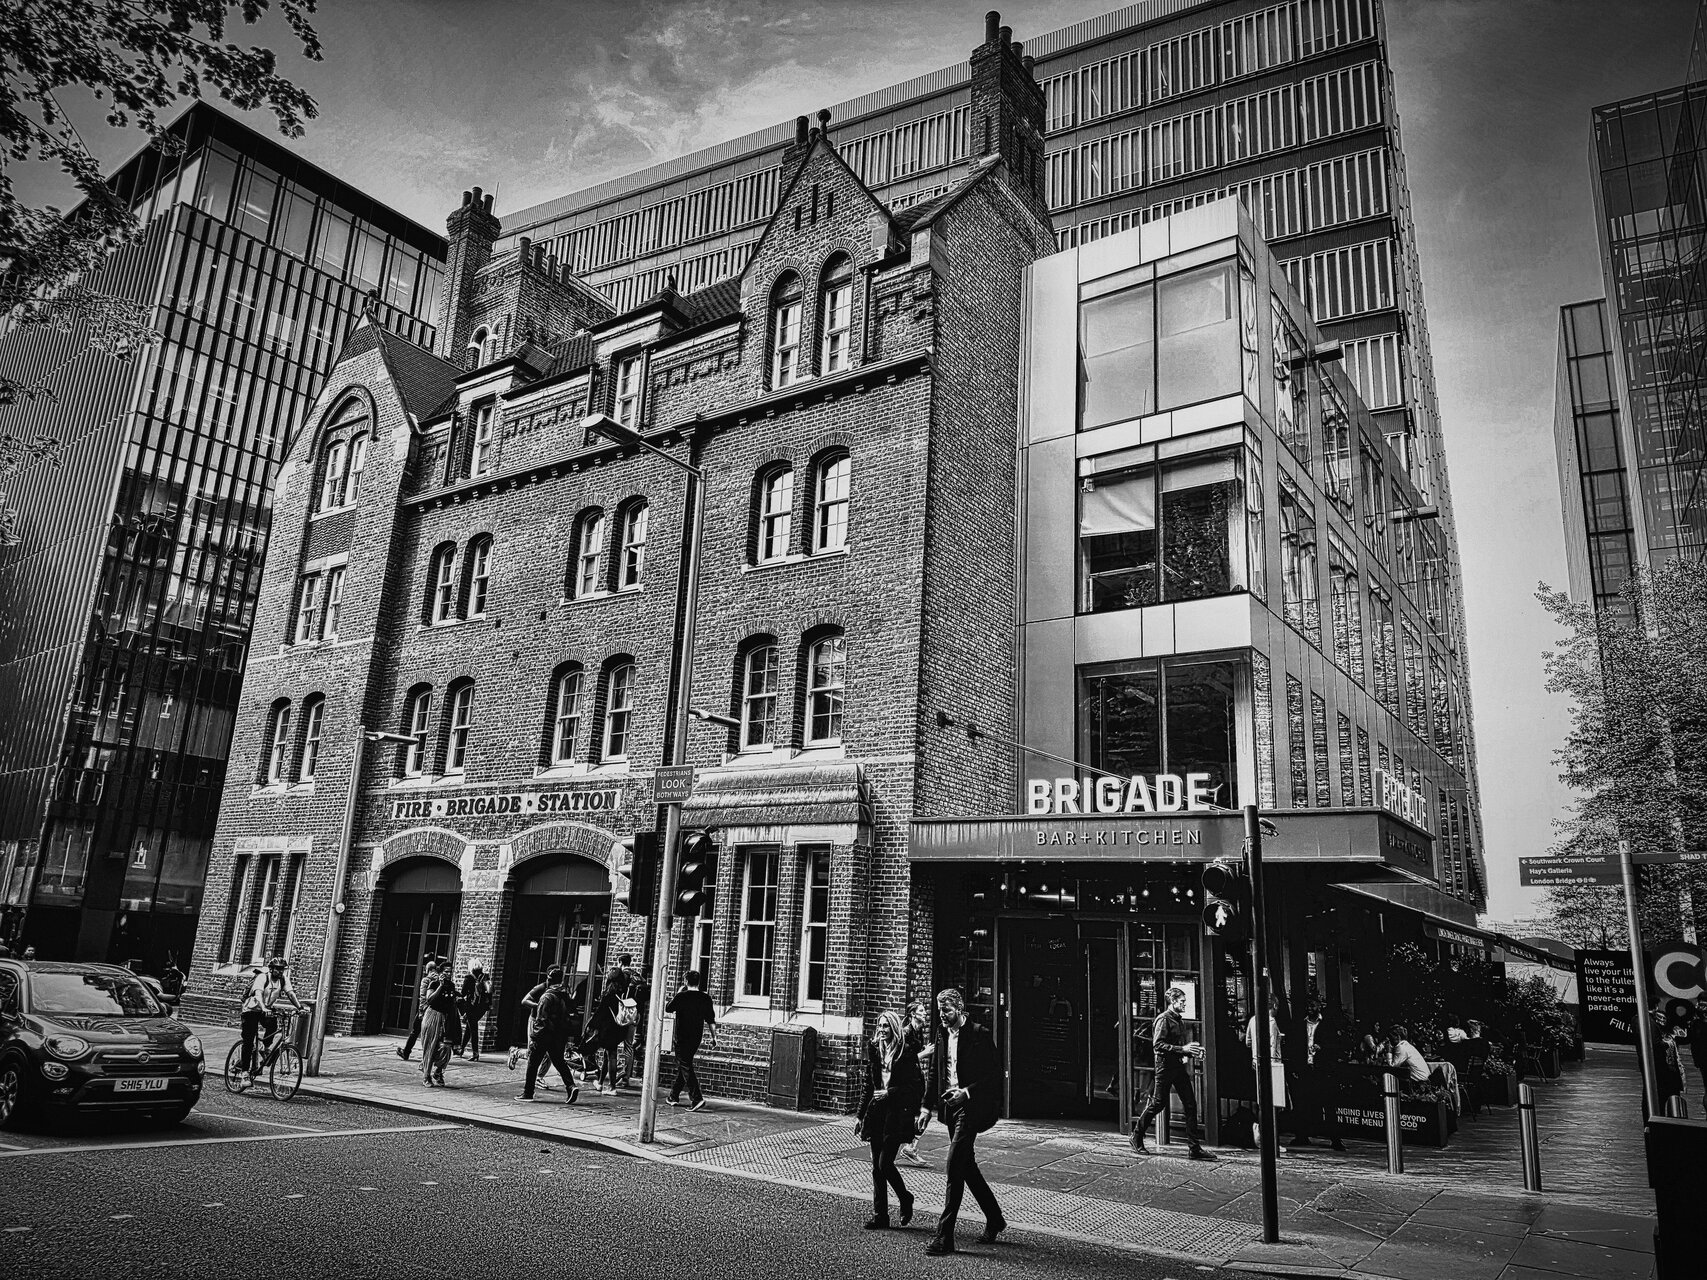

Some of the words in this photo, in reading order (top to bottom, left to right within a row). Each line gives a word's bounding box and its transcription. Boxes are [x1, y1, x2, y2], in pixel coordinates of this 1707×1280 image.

[661, 779, 686, 789] LOOK
[1028, 773, 1212, 815] BRIGADE
[395, 801, 433, 819] FIRE
[446, 796, 522, 816] BRIGADE
[537, 791, 617, 812] STATION
[1679, 853, 1701, 861] SHAD
[1583, 958, 1614, 968] Always
[1584, 967, 1599, 975] live
[1612, 977, 1635, 985] fulles
[1586, 985, 1602, 993] like
[1604, 986, 1617, 994] it's
[1587, 995, 1637, 1003] never-endi
[1609, 1017, 1625, 1031] Fill
[145, 1079, 163, 1089] YLU
[1336, 1107, 1361, 1117] NGING
[1362, 1110, 1385, 1120] LIVES
[1345, 1116, 1360, 1125] THE
[1361, 1118, 1384, 1128] MENU
